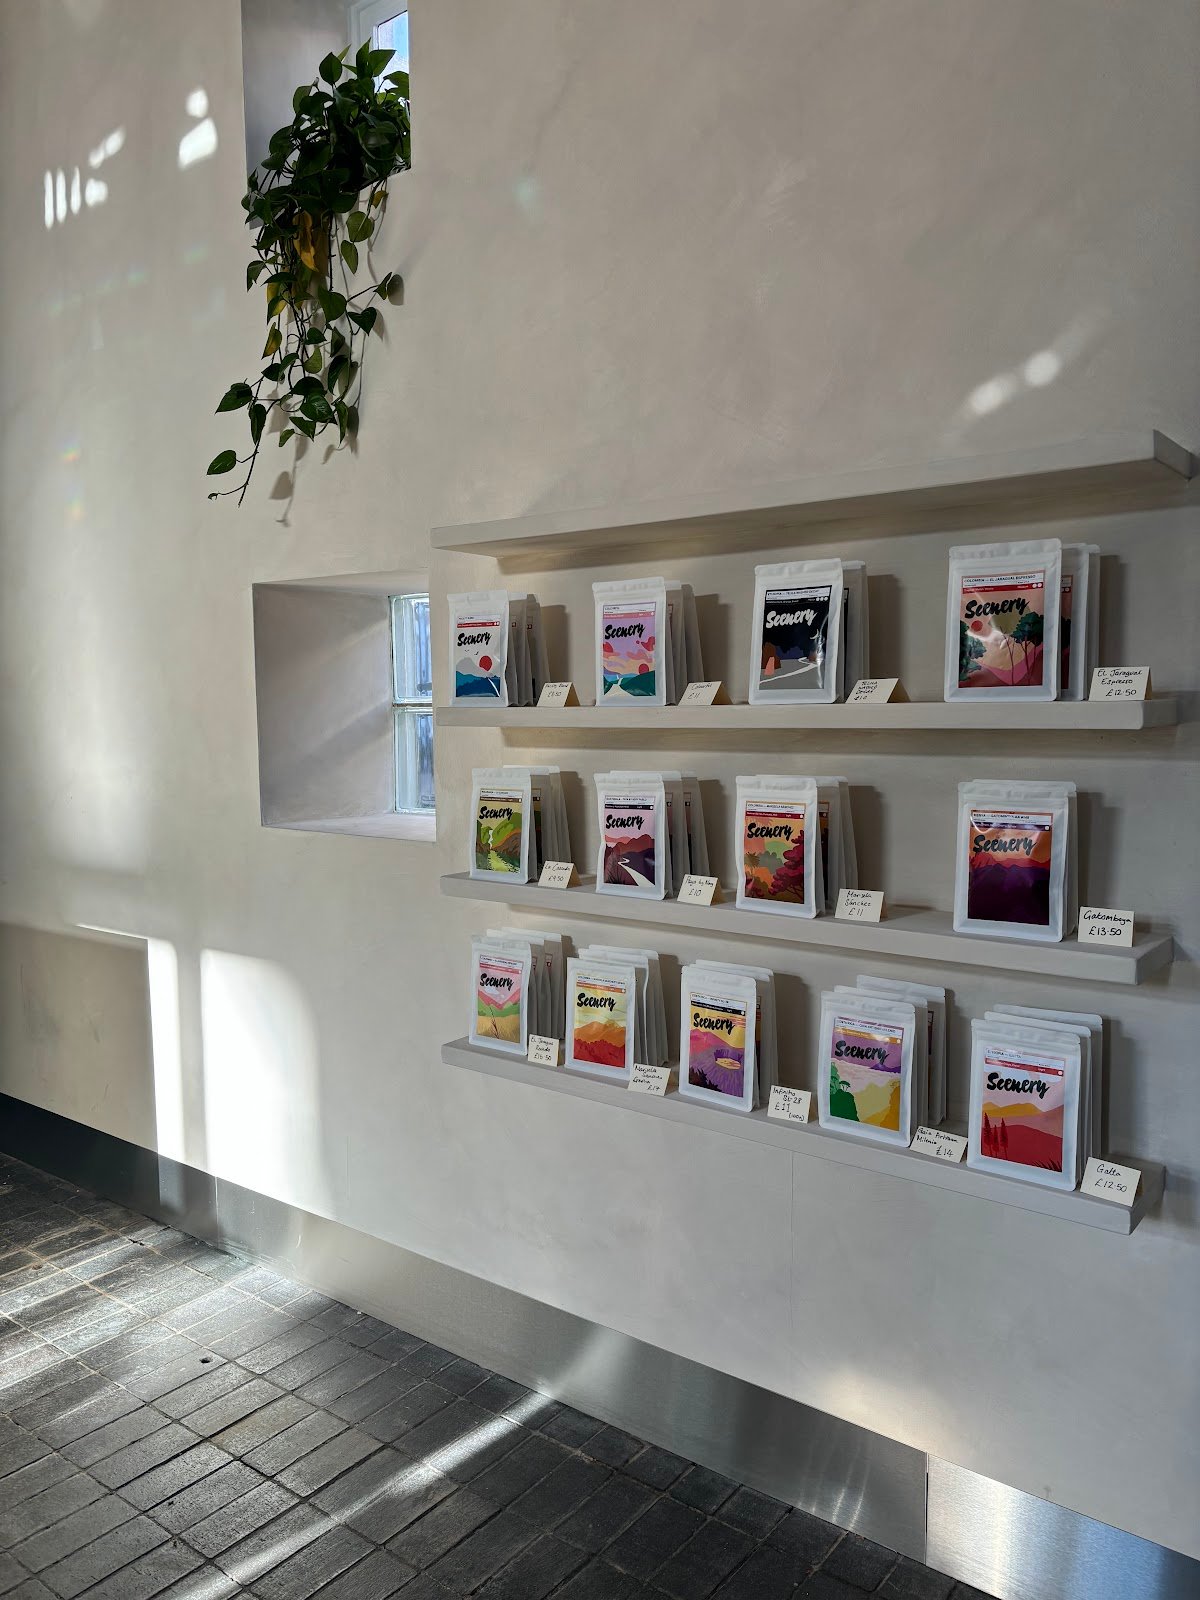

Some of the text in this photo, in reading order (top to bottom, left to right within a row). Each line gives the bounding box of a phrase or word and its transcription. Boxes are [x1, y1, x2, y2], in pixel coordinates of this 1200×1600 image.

[964, 597, 1031, 619] Scenery
[765, 608, 819, 629] Scenery
[457, 632, 492, 647] Scenery
[604, 622, 646, 640] Scenery
[1101, 677, 1133, 686] Espresso
[479, 805, 514, 821] Scenery
[605, 813, 646, 831] Scenery
[746, 822, 795, 842] Scenery
[972, 834, 1038, 857] Scenery
[480, 973, 515, 992] Scenery
[577, 992, 617, 1012] Scenery
[693, 1012, 736, 1036] Scenery
[834, 1039, 890, 1066] Scenery
[986, 1072, 1051, 1099] Scenery
